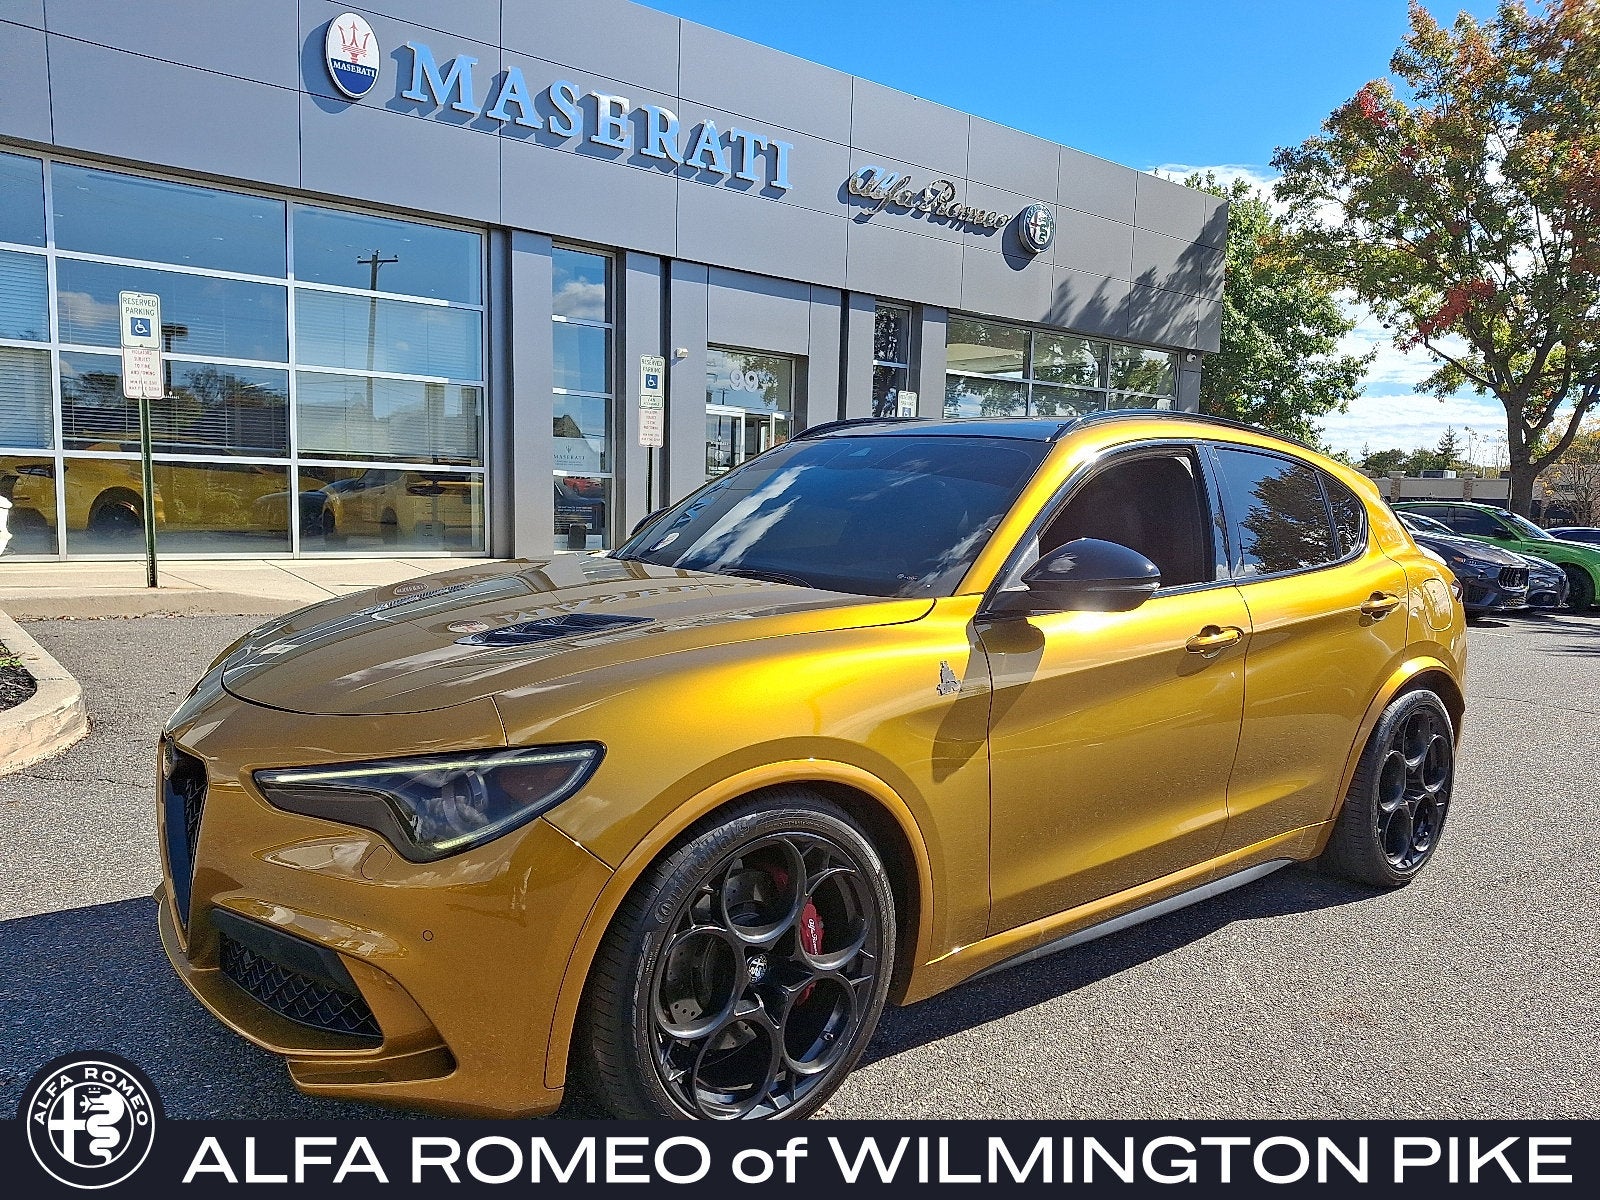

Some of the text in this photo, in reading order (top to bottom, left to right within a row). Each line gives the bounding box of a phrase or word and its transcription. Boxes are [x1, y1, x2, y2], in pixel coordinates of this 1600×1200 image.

[333, 60, 375, 77] MASERATI
[401, 40, 794, 190] MASERATI
[848, 164, 917, 215] Alfa
[918, 178, 1013, 229] Romeo
[122, 297, 157, 307] RESERVED
[125, 307, 155, 316] PARKING
[641, 358, 662, 366] RESERVED
[729, 368, 759, 392] 99
